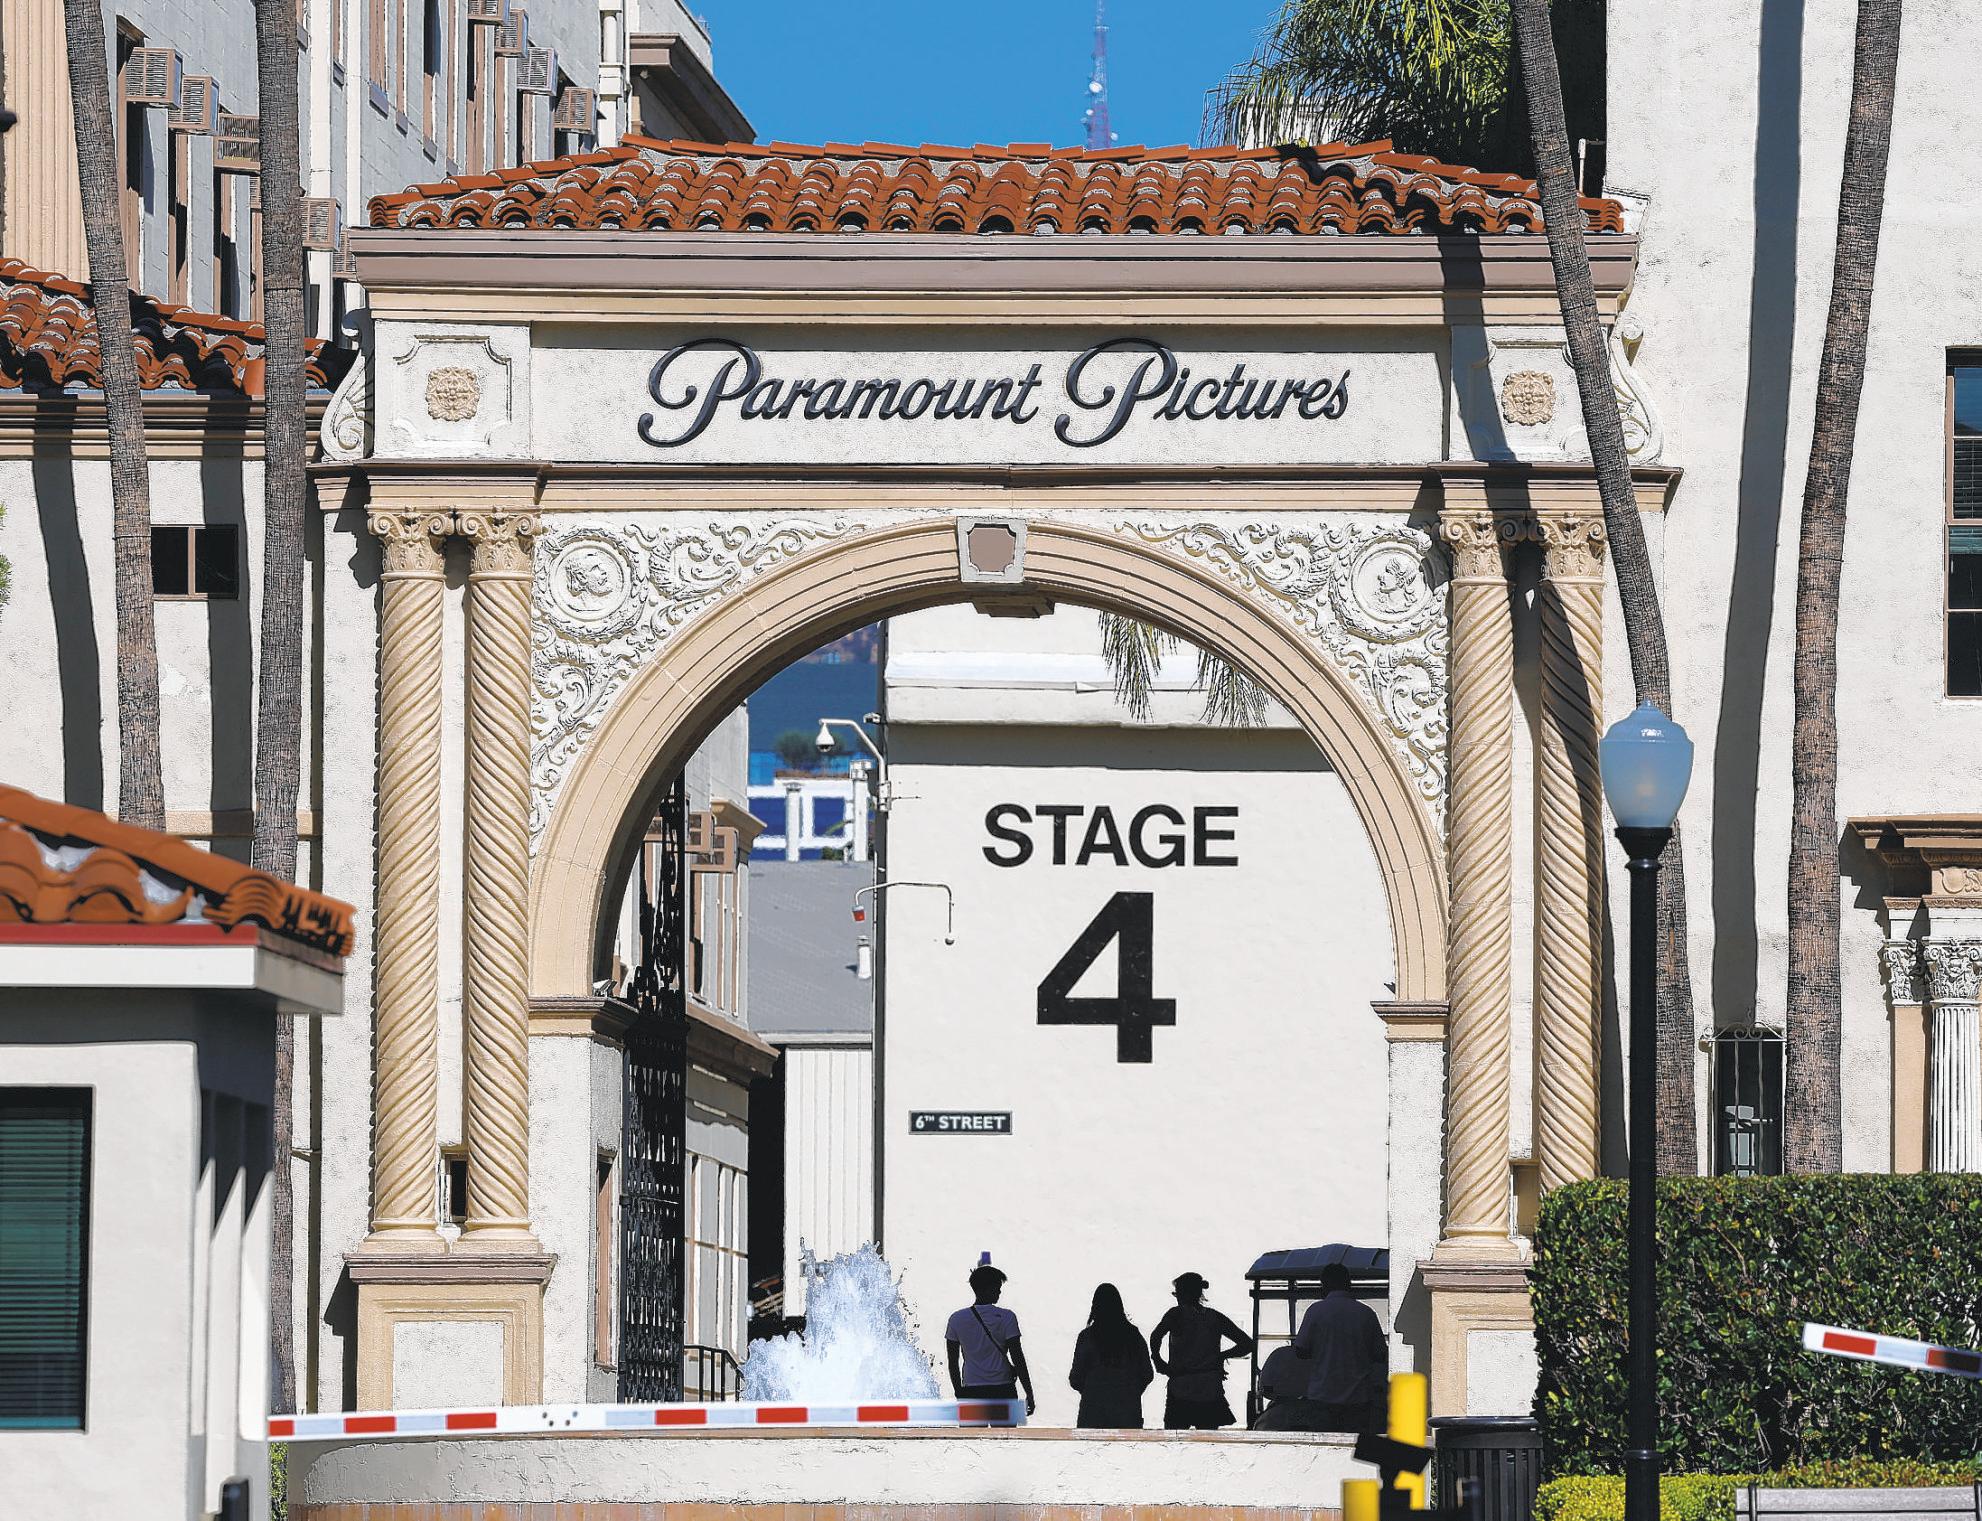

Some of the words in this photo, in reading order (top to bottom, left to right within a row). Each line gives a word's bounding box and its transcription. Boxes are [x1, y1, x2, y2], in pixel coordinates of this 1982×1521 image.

[637, 337, 1042, 448] Paramount
[1054, 337, 1349, 448] Pictures
[982, 803, 1239, 868] STAGE
[1036, 891, 1177, 1063] 4
[915, 1115, 935, 1129] 6TH
[938, 1115, 1006, 1130] STREET
